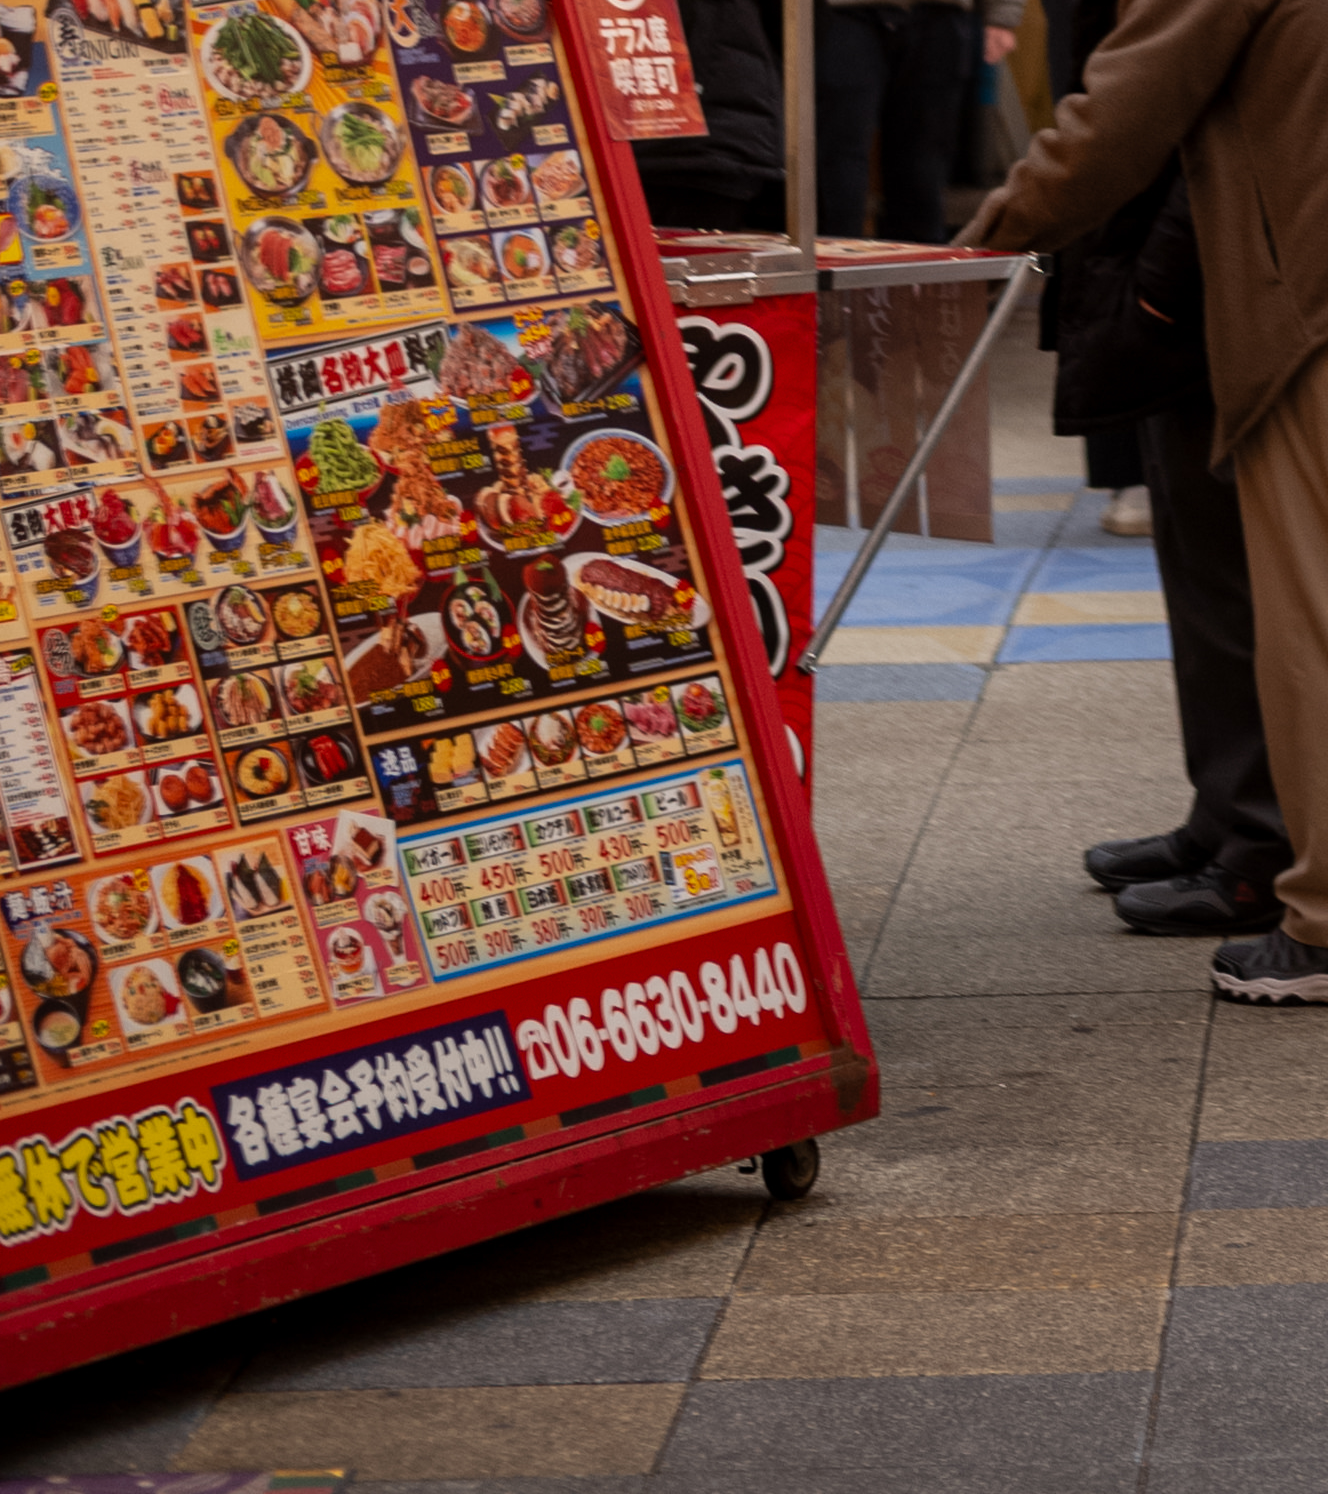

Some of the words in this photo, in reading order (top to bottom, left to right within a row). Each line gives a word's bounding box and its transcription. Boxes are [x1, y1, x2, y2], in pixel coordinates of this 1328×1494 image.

[600, 17, 671, 55] テラス席
[610, 56, 676, 97] 喫煙可
[543, 941, 807, 1079] 06-6630-8440
[227, 1024, 521, 1168] 各種宴会予約受付中!!
